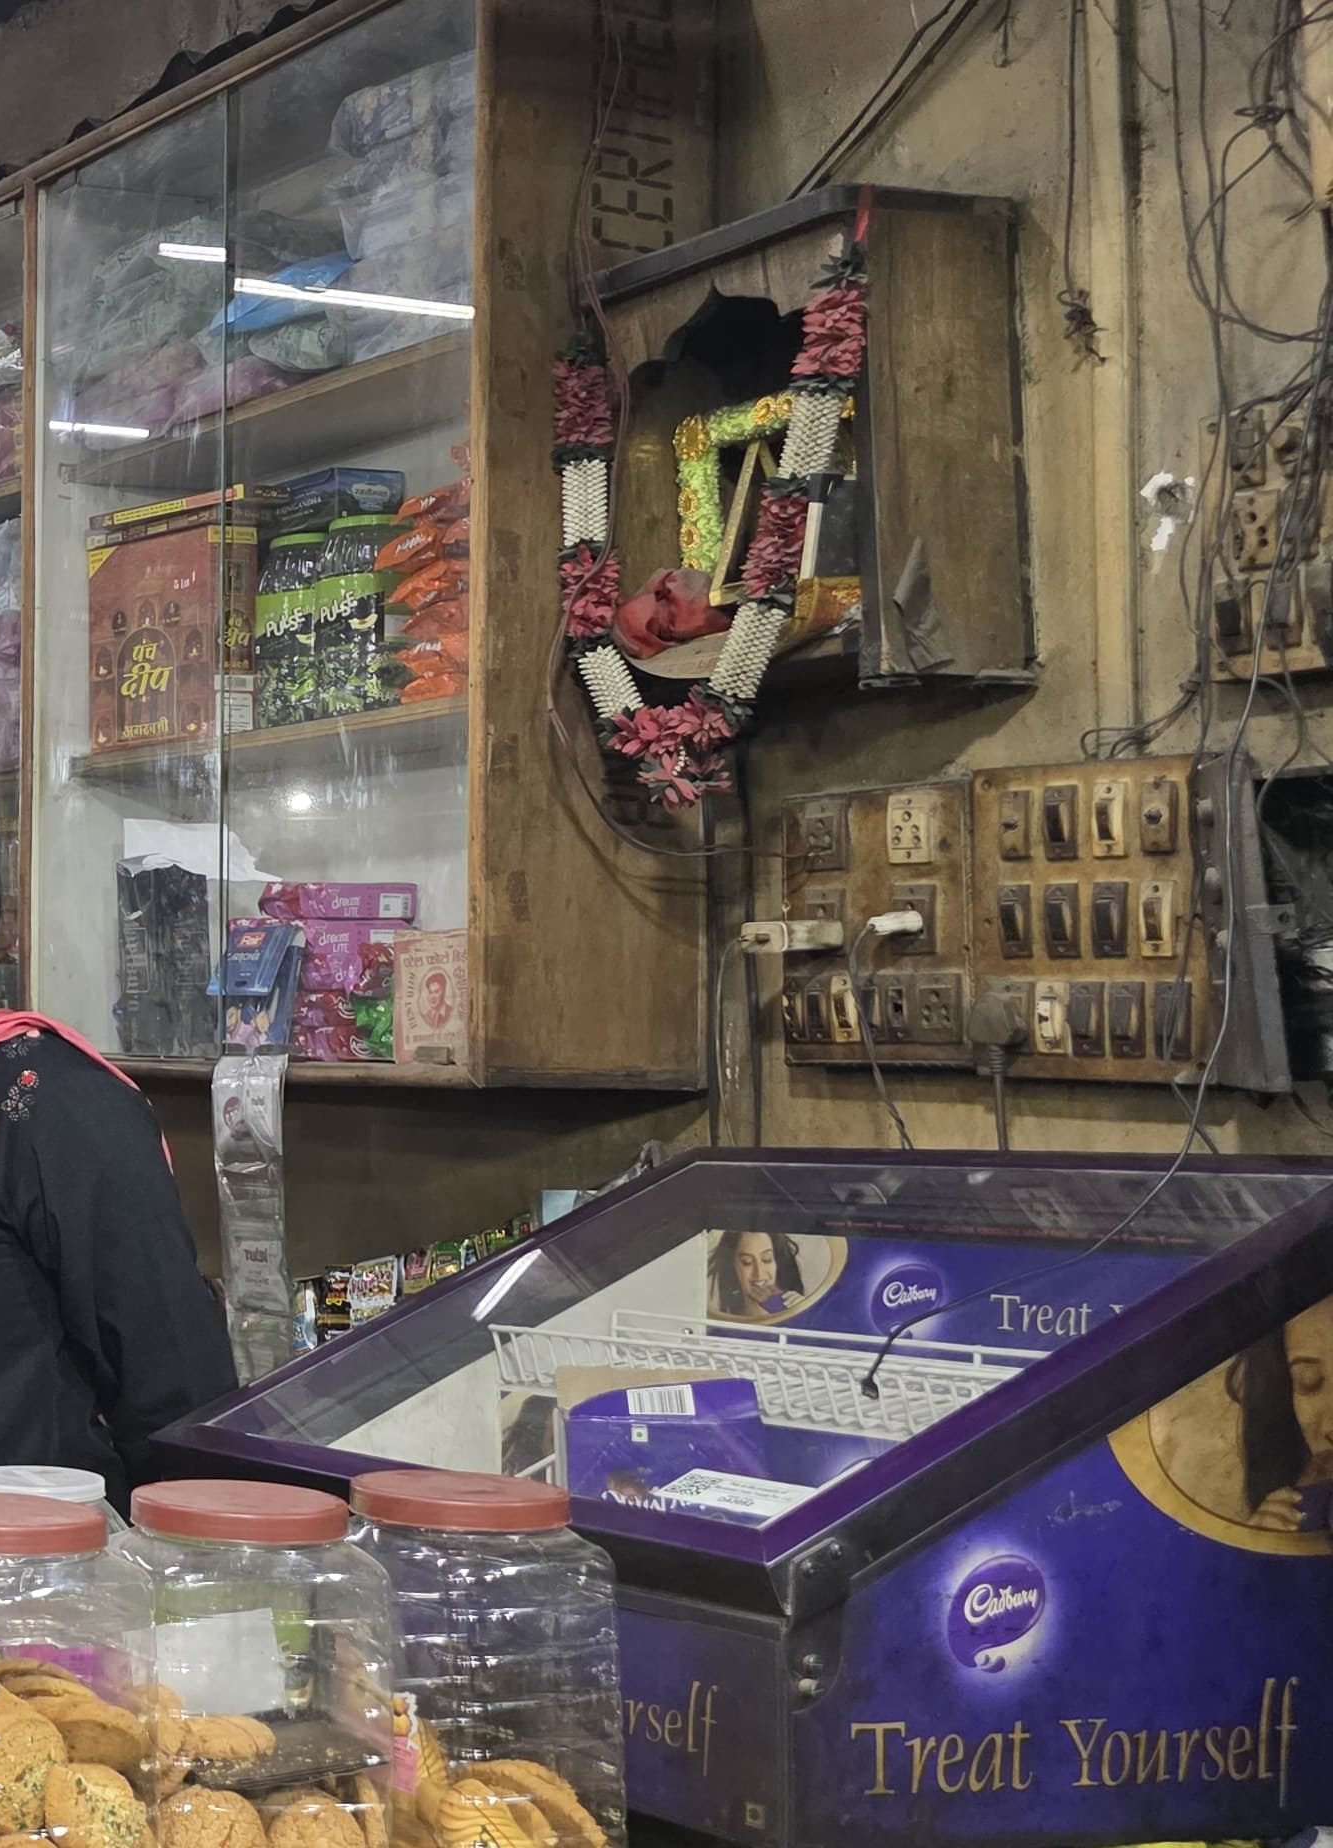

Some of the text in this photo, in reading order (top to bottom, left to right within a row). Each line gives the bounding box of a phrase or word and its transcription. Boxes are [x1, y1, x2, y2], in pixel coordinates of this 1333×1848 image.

[266, 607, 306, 638] PULSE
[320, 591, 358, 624] PULSE
[121, 662, 174, 698] दीप
[883, 1280, 937, 1308] Cadbury
[989, 1293, 1093, 1337] Treat
[963, 1582, 1039, 1625] Cadbury
[624, 1680, 718, 1778] rself
[850, 1675, 1300, 1809] Treat Yourself
